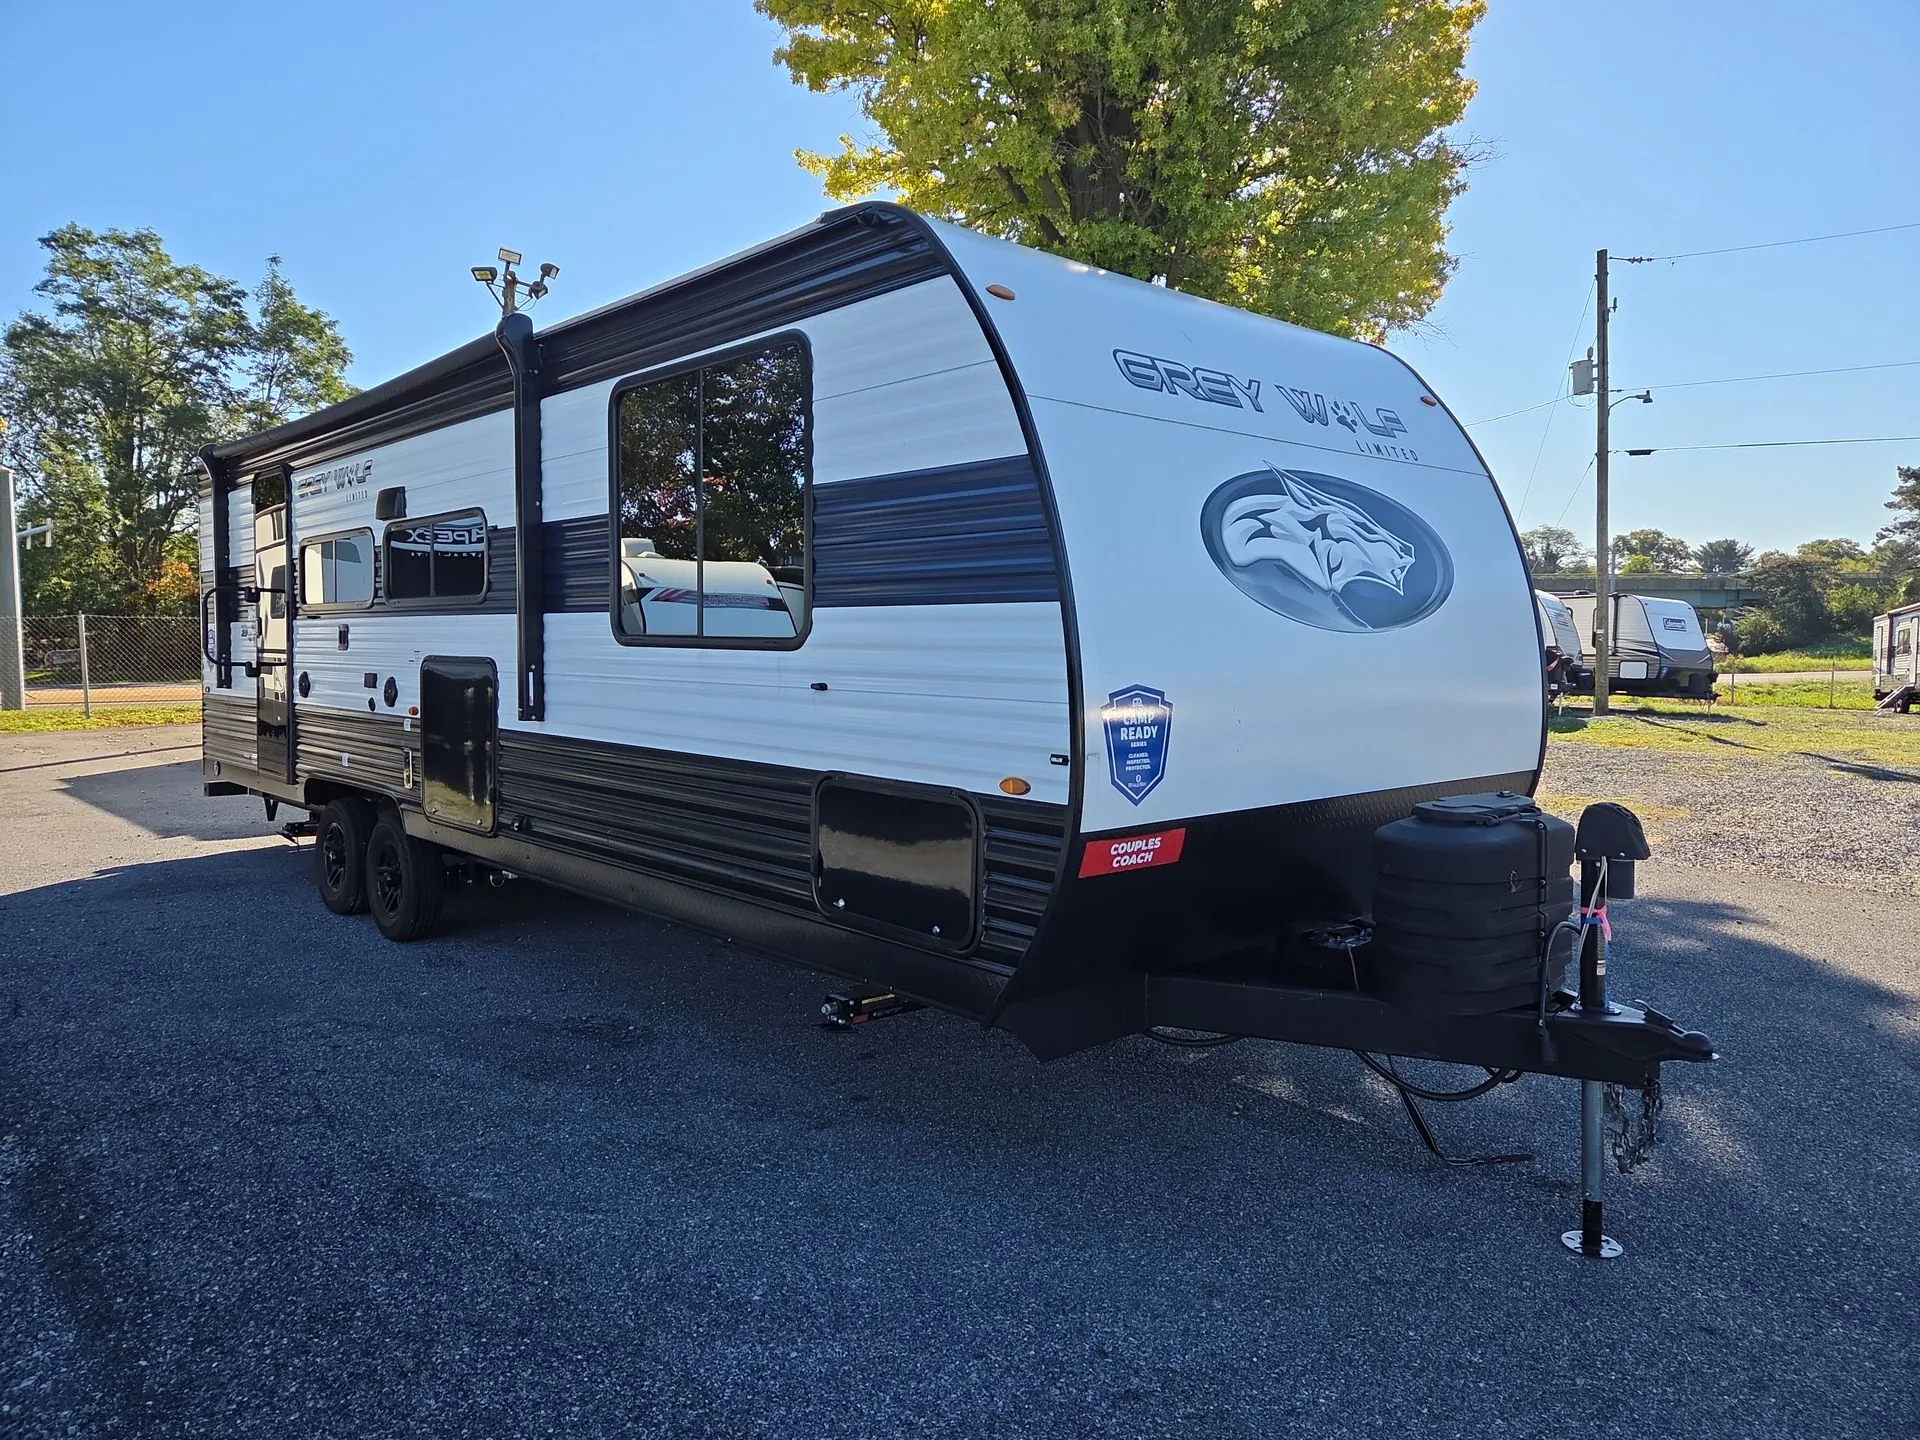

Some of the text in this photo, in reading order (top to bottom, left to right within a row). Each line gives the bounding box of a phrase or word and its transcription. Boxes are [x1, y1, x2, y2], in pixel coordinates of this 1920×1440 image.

[1112, 348, 1264, 413] GREY
[1355, 440, 1419, 462] LIMITED
[297, 471, 331, 498] GREY
[346, 490, 368, 503] LIMITED
[1122, 712, 1155, 726] CAMP
[1120, 725, 1158, 741] READY
[1110, 837, 1162, 856] COUPLES
[1112, 851, 1154, 869] COACH
